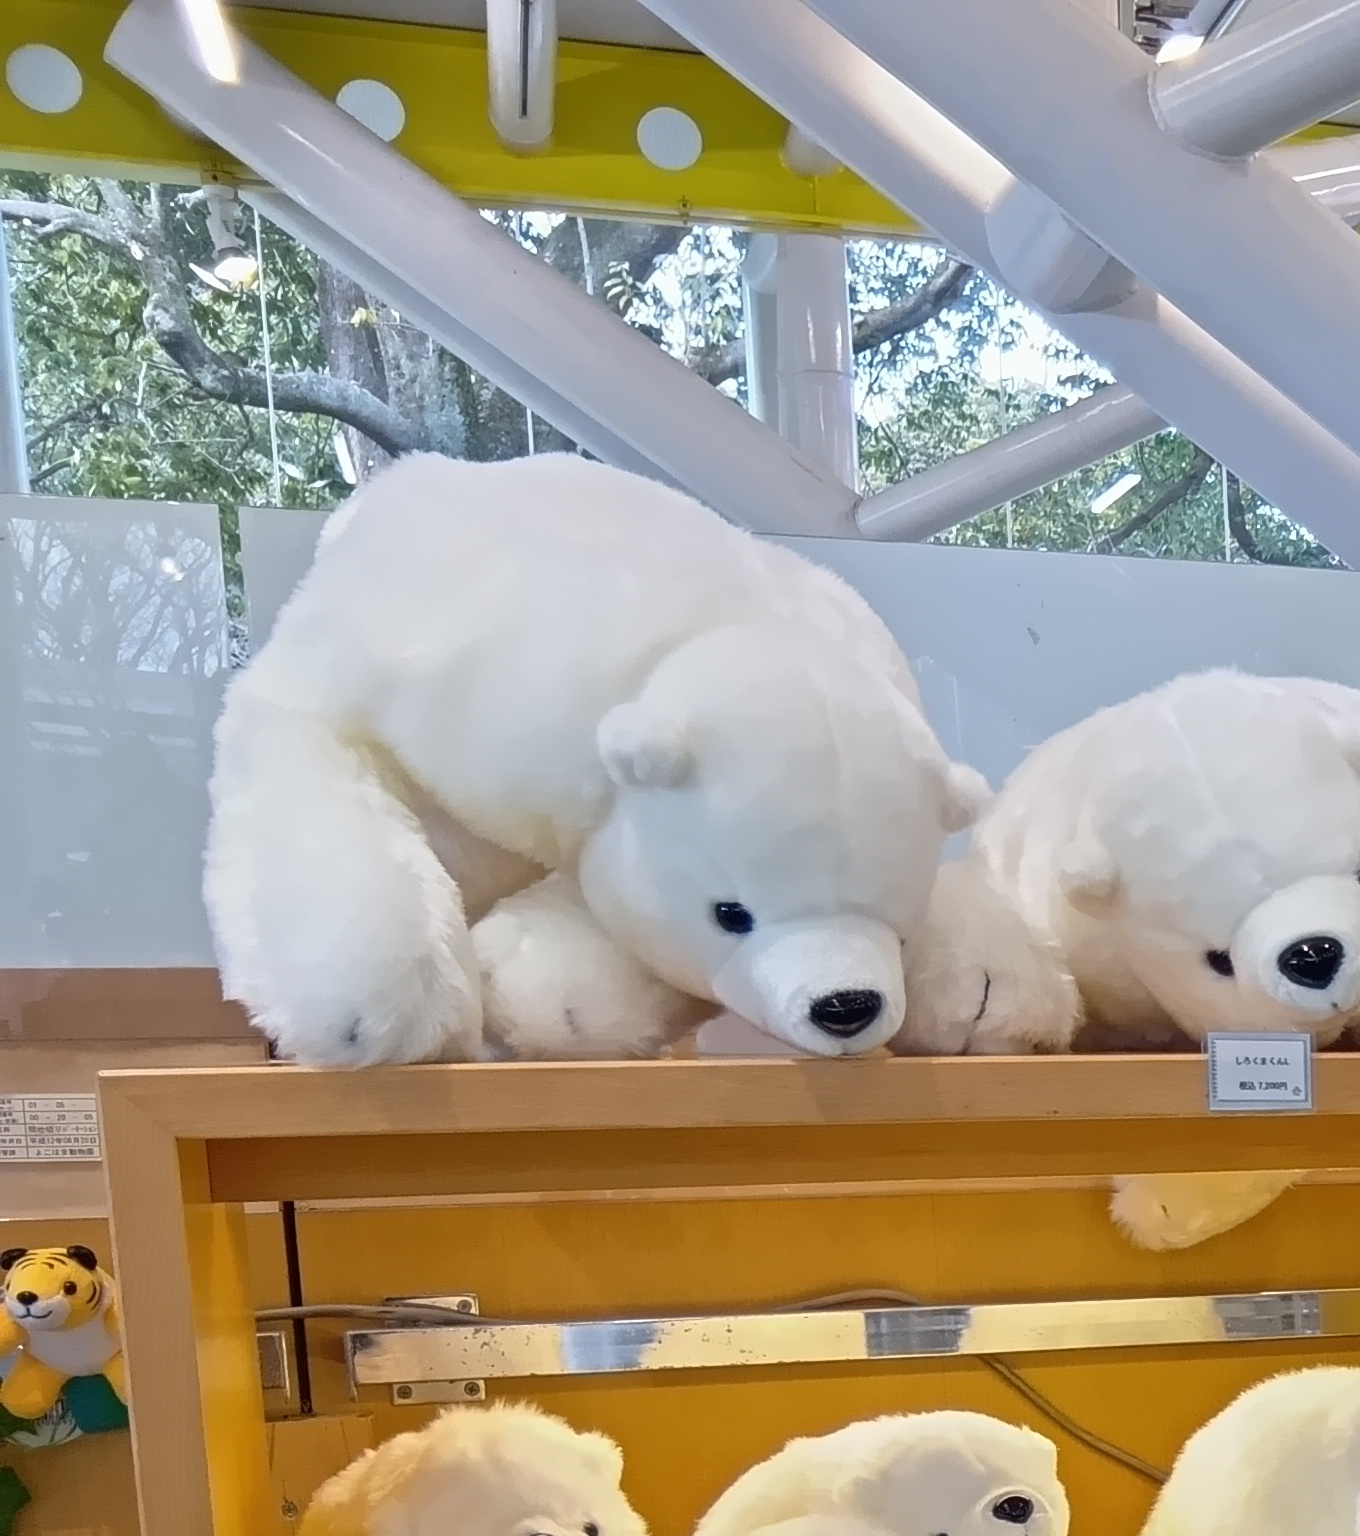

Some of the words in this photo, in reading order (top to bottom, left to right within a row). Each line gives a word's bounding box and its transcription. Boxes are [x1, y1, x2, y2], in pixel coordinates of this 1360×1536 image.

[1235, 1056, 1291, 1066] しろくまくんL
[35, 1148, 95, 1156] よこはま動物園
